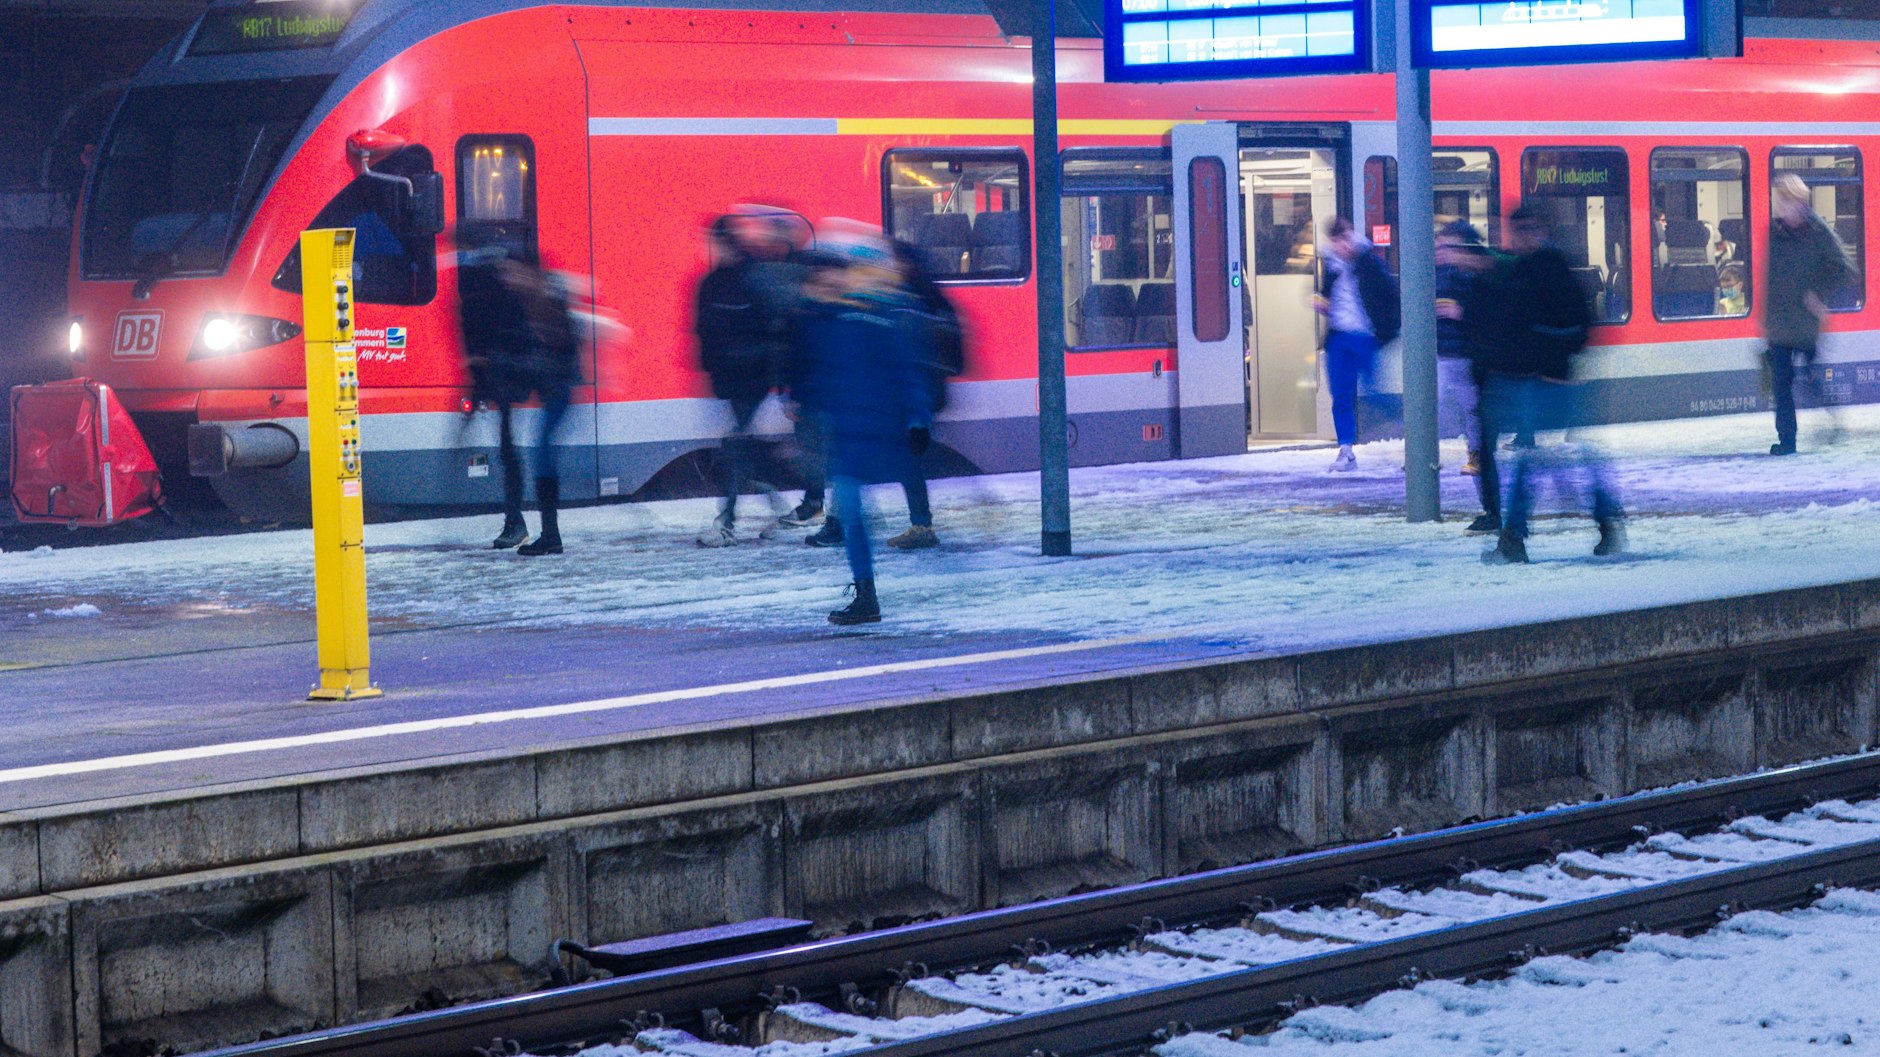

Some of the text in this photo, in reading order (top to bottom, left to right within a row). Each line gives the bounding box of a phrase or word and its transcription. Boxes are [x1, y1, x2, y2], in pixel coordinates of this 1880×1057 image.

[1559, 168, 1608, 186] Ludwigslust
[118, 319, 156, 351] DB
[355, 328, 384, 338] enburg
